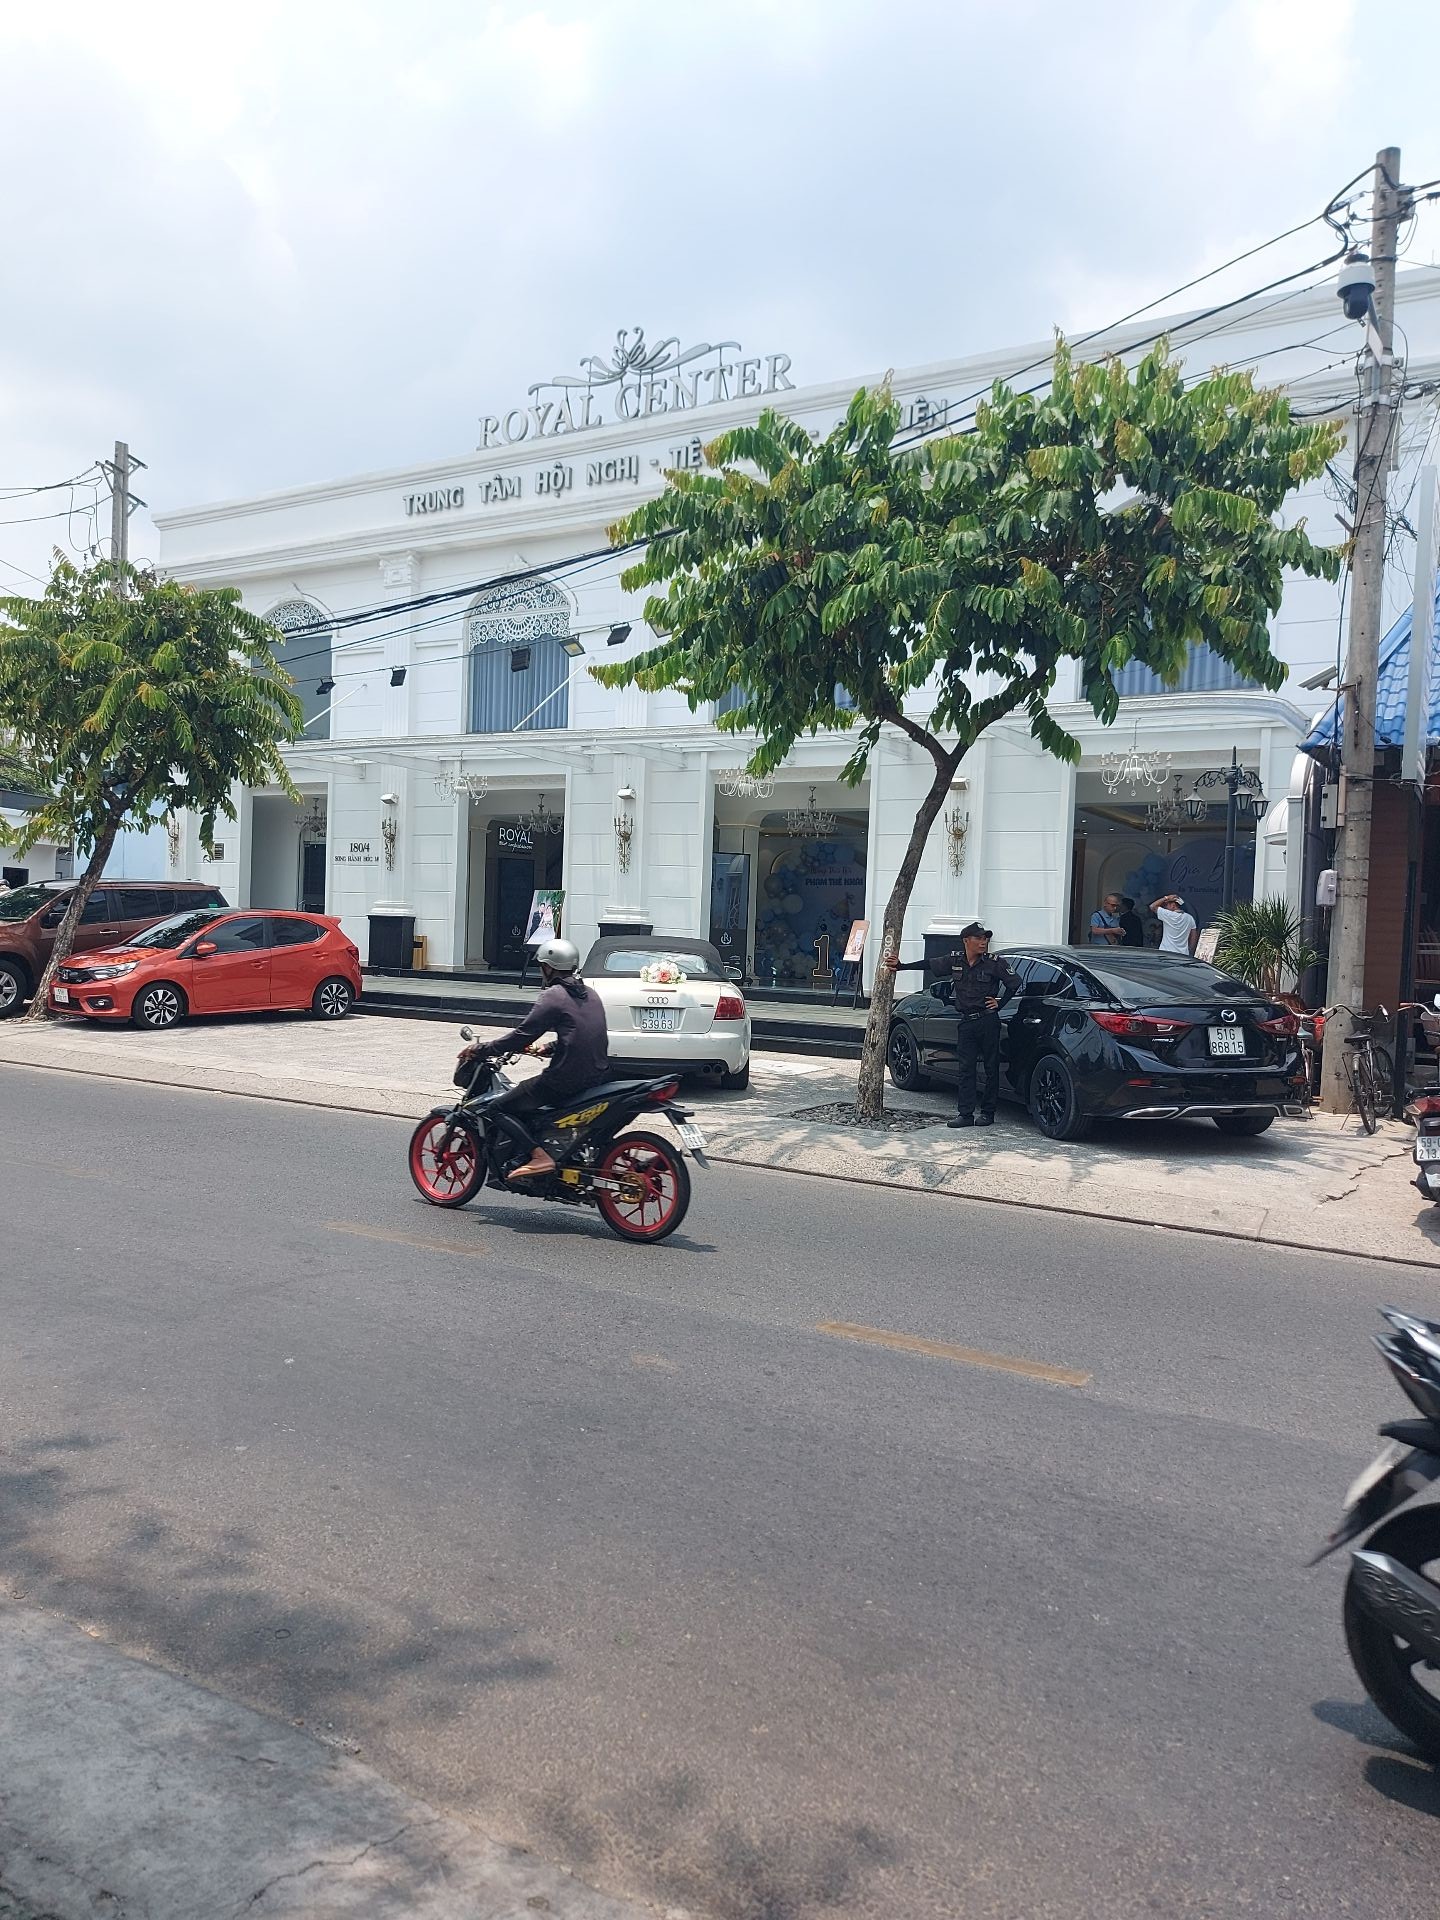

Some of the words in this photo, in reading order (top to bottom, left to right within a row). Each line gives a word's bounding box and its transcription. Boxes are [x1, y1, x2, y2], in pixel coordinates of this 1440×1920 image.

[476, 394, 602, 450] ROYAL
[615, 353, 796, 421] CENTER
[403, 486, 464, 515] TRUNG
[479, 474, 521, 502] TÂM
[535, 462, 573, 498] HỘI
[586, 455, 639, 485] NGHỊ
[669, 436, 703, 474] TIỆ
[900, 395, 947, 435] IỆN
[499, 827, 534, 844] ROYAL
[648, 1008, 666, 1019] 51A
[642, 1019, 673, 1030] 539.63
[1216, 1028, 1236, 1040] 51G
[1211, 1041, 1244, 1054] 868.15
